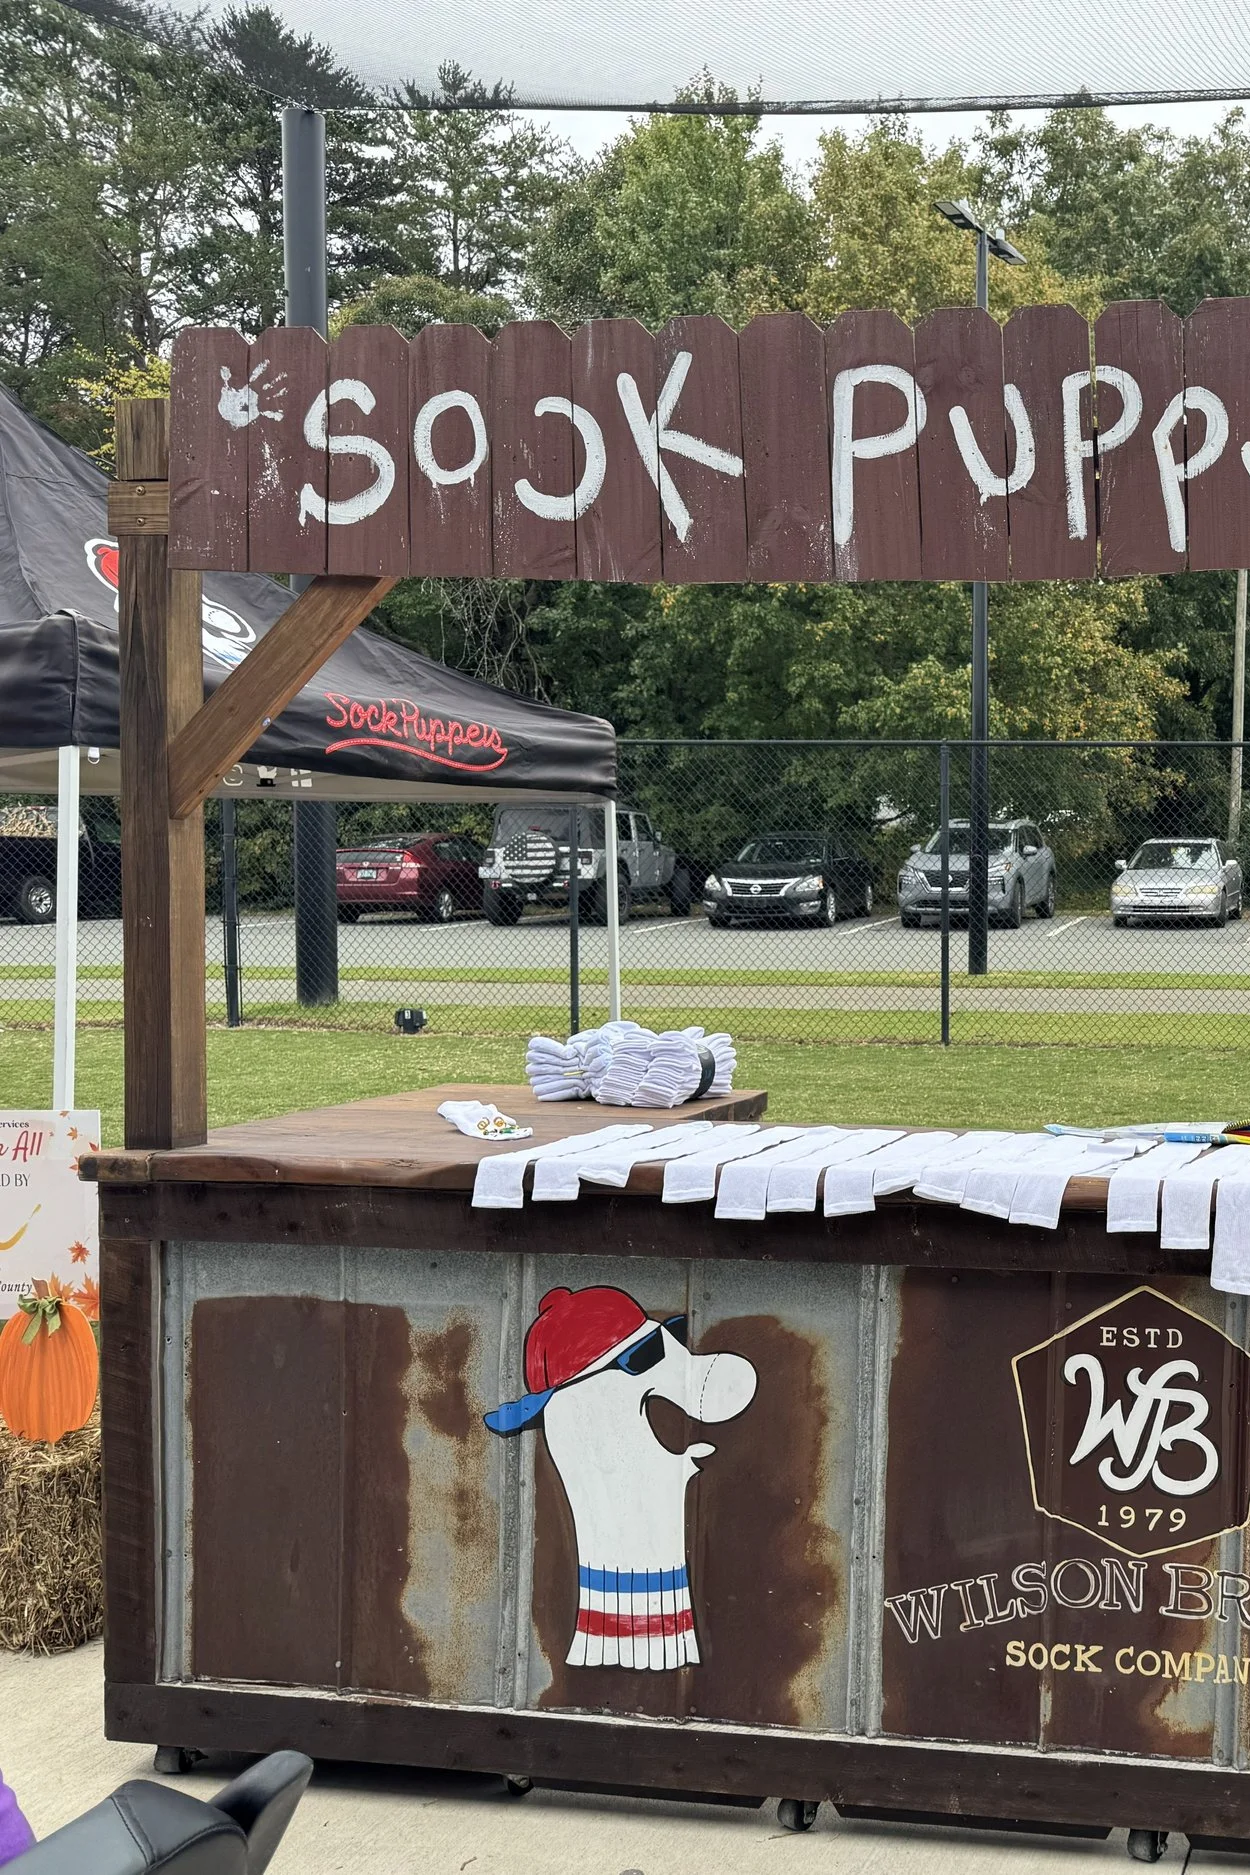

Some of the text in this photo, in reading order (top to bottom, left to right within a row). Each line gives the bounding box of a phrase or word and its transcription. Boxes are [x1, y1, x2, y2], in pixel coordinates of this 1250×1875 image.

[12, 1130, 43, 1163] All
[14, 1173, 31, 1187] BY
[0, 1280, 32, 1296] ounty
[1099, 1326, 1184, 1348] ESTD
[1098, 1505, 1187, 1532] 1979
[885, 1558, 1148, 1645] WILSON
[1006, 1640, 1103, 1673] SOCK
